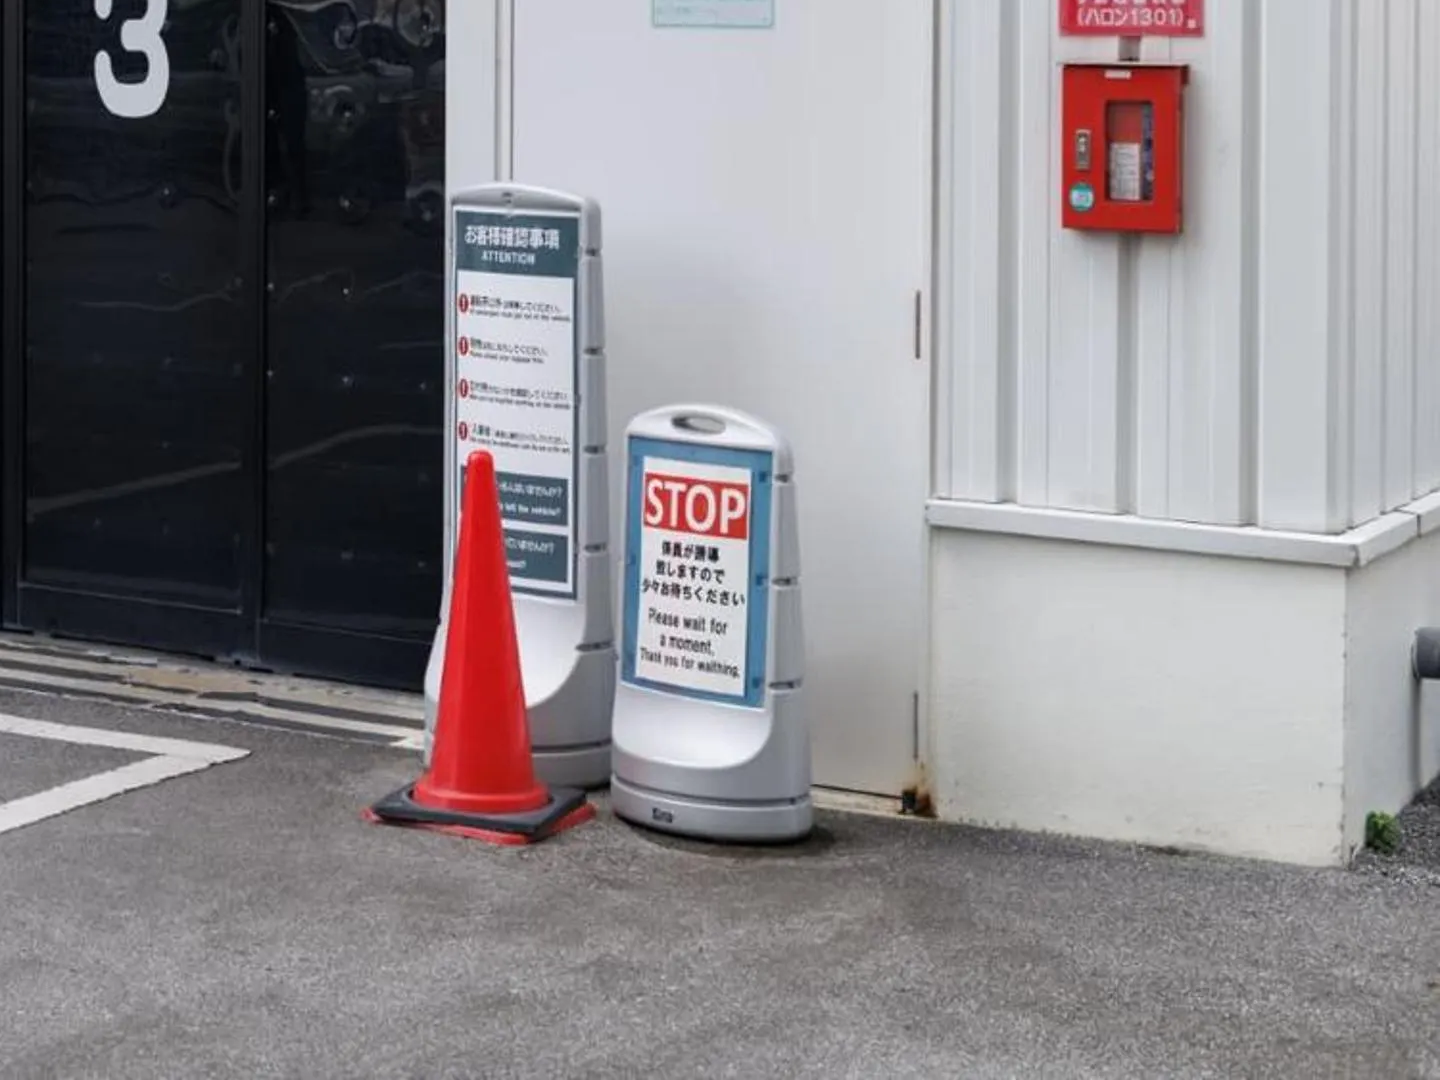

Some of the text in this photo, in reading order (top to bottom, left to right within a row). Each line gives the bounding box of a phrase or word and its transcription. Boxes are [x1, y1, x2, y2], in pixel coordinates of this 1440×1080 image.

[481, 251, 536, 265] ATTENTION
[645, 478, 746, 534] STOP
[656, 560, 725, 584] 致しますので
[641, 578, 746, 606] 少々お待ちください
[648, 607, 728, 636] Please wait for
[660, 635, 665, 647] a
[664, 655, 678, 668] you
[681, 656, 695, 670] for
